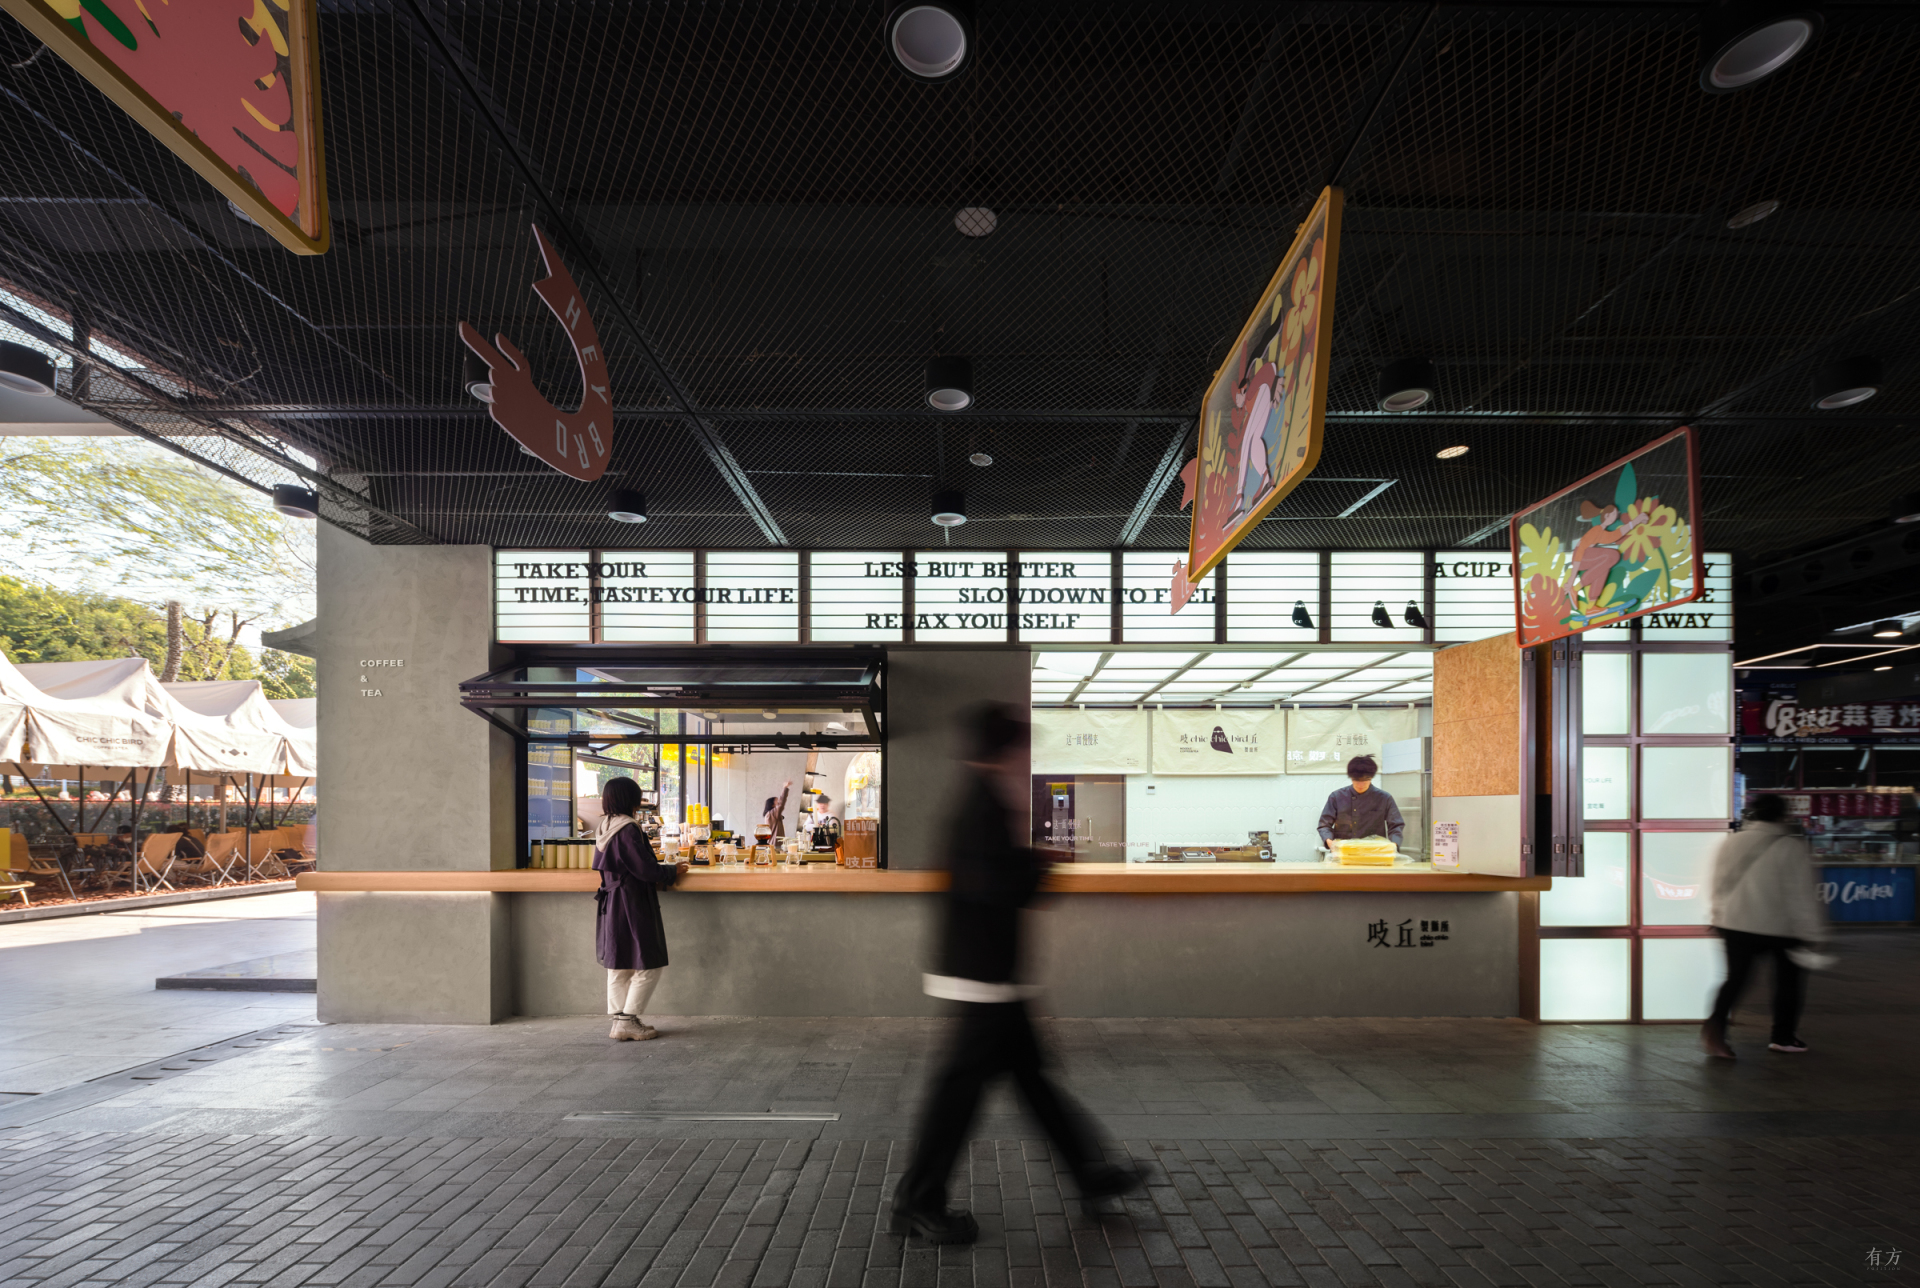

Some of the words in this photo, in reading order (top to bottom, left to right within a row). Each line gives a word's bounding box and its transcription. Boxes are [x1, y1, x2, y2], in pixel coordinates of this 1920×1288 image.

[514, 562, 580, 578] TAKE
[582, 562, 648, 578] YOUR
[865, 562, 918, 578] LESS
[928, 562, 974, 578] BUT
[982, 562, 1076, 578] BETTER
[1432, 562, 1447, 578] A
[1452, 562, 1502, 578] CUP
[514, 587, 590, 606] TIME,
[592, 587, 664, 603] TASTE
[667, 588, 734, 604] YOUR
[738, 588, 794, 604] LIFE
[959, 588, 1106, 604] SLOWDOWN
[1115, 588, 1147, 604] TO
[1154, 588, 1216, 604] FEL
[866, 614, 950, 630] RELAX
[956, 614, 1080, 630] YOURSELF
[1650, 612, 1714, 628] AWAY
[360, 660, 404, 668] COFFEE
[360, 674, 368, 682] &
[1367, 918, 1416, 948] 吱丘
